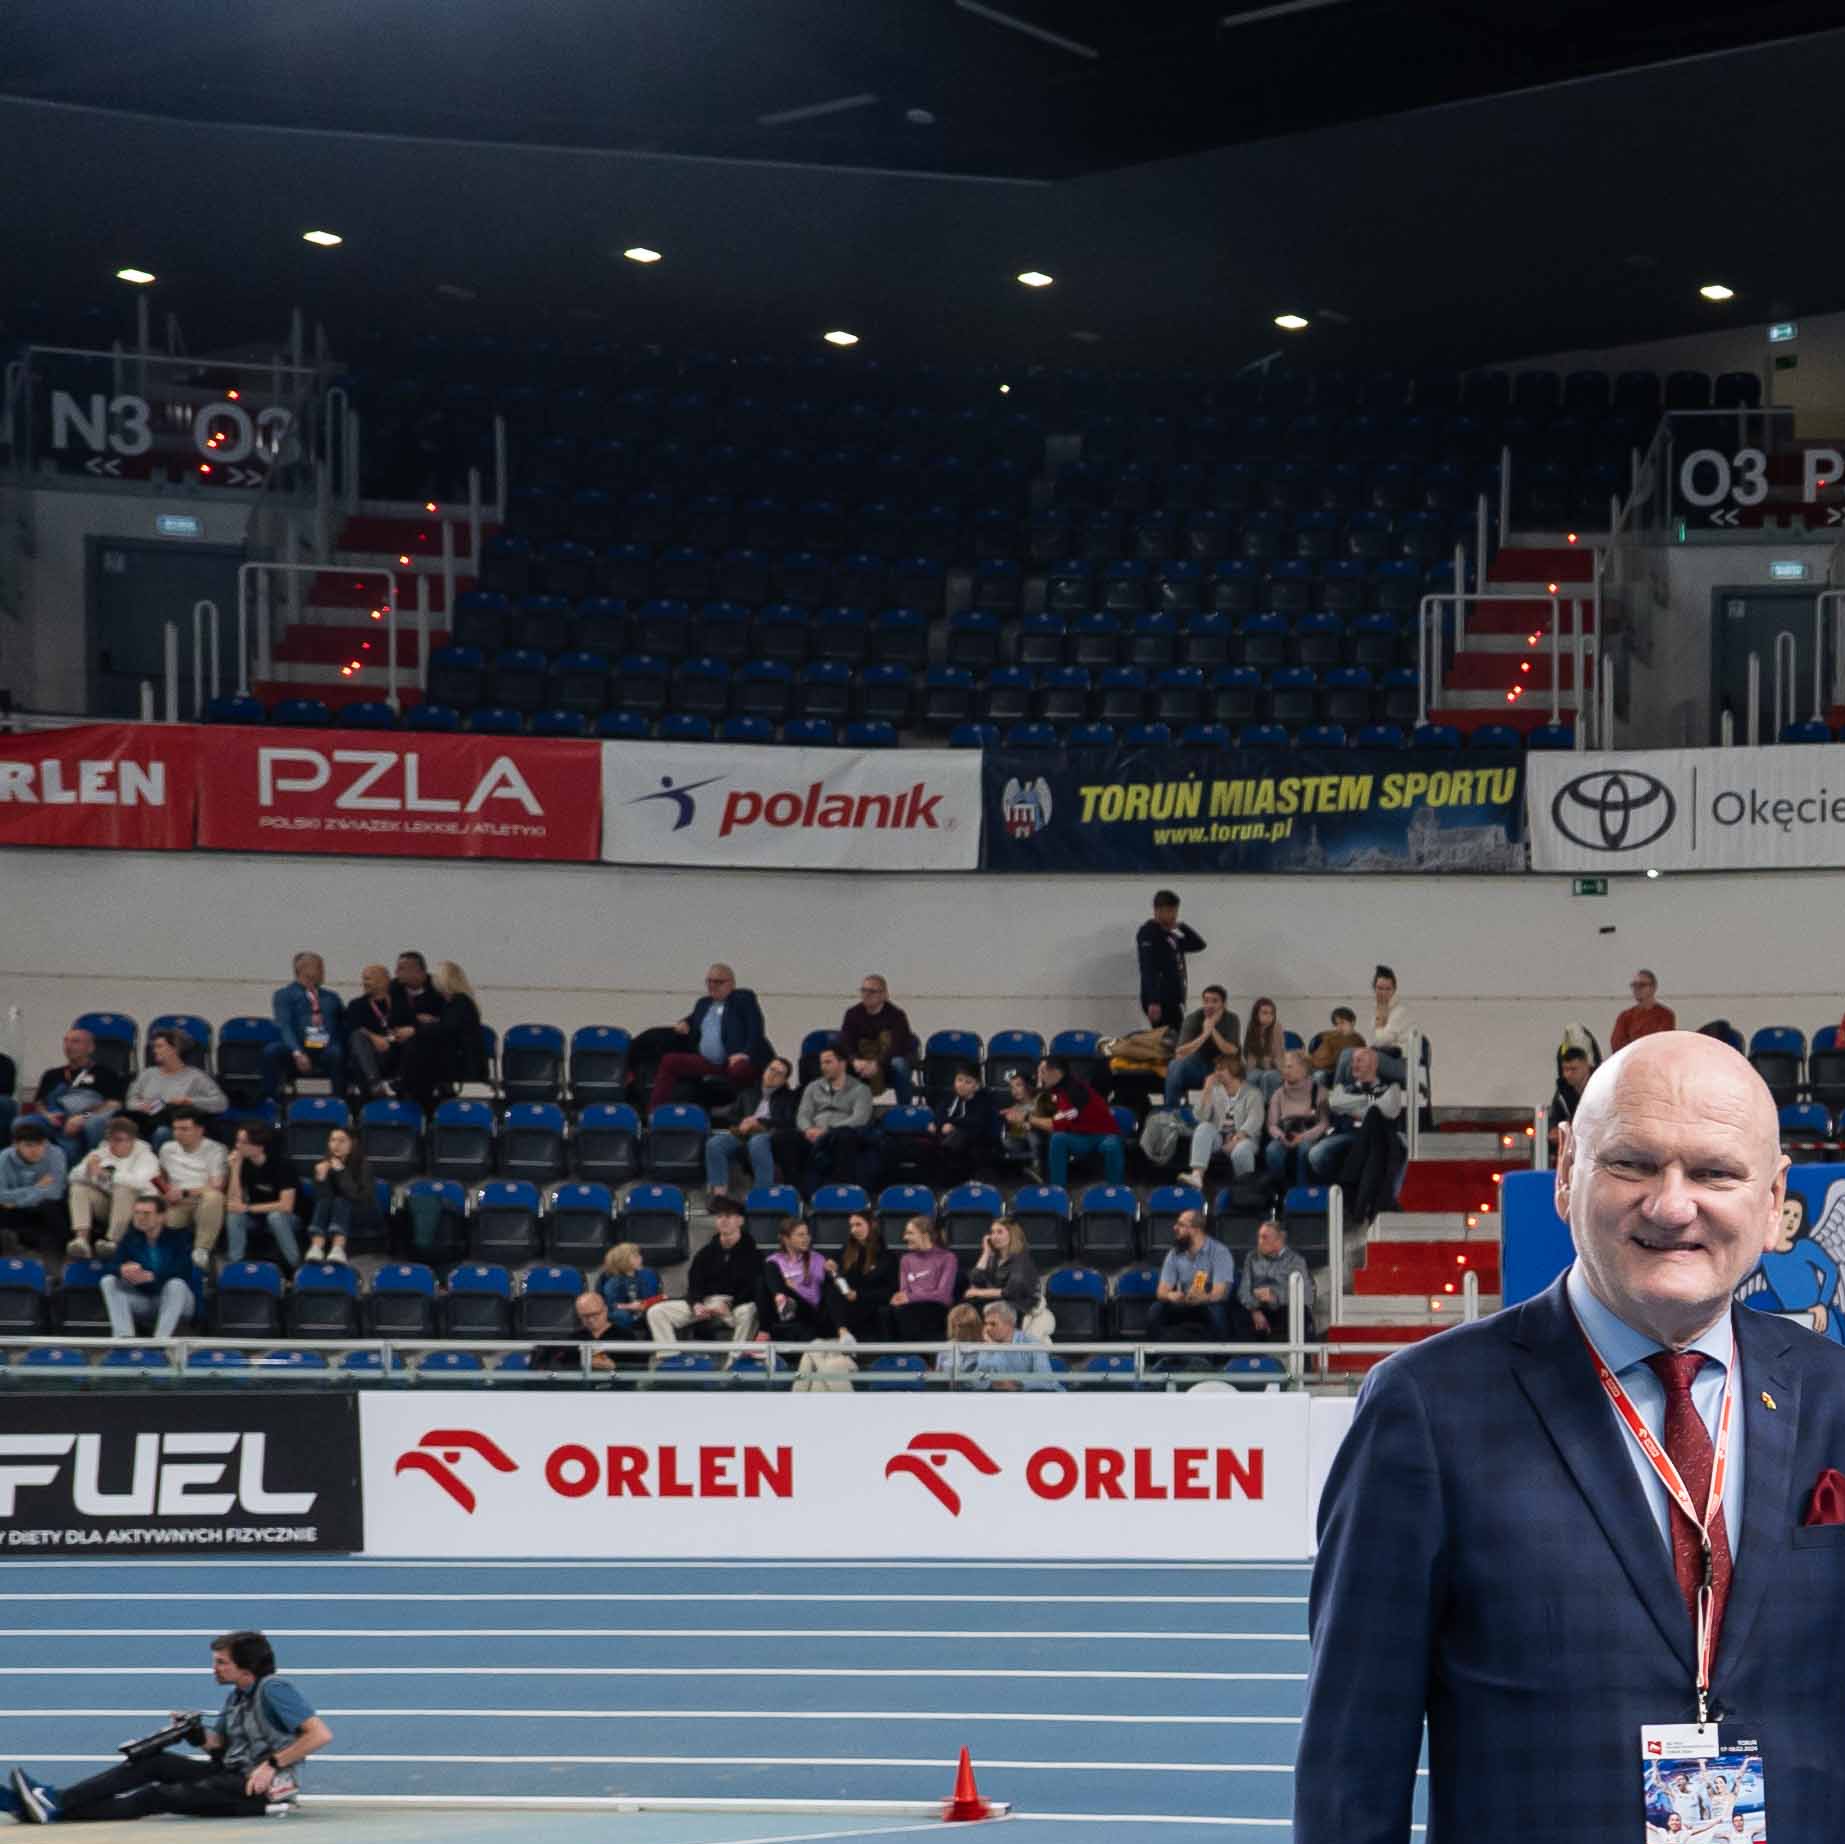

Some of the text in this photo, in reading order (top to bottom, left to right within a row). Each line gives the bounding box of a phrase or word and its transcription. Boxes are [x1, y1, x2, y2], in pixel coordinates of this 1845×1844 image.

[52, 390, 151, 456] N3
[1680, 449, 1769, 506] O3
[0, 759, 166, 806] RLEN
[259, 747, 544, 816] PZLA
[1079, 767, 1517, 823] TORUŃ MIASTEM SPORTU
[259, 816, 321, 829] POLSKI
[404, 820, 469, 834] LEKKIEJ
[472, 823, 546, 836] ATLETYKI
[717, 782, 940, 839] polanik
[1153, 819, 1292, 845] www.torun.pl
[544, 1444, 793, 1498] ORLEN
[1026, 1446, 1264, 1500] ORLEN
[8, 1530, 63, 1546] DIETY
[65, 1529, 104, 1545] DLA
[105, 1528, 223, 1544] AKTYWNYCH
[225, 1527, 317, 1542] FIZYCZNIE
